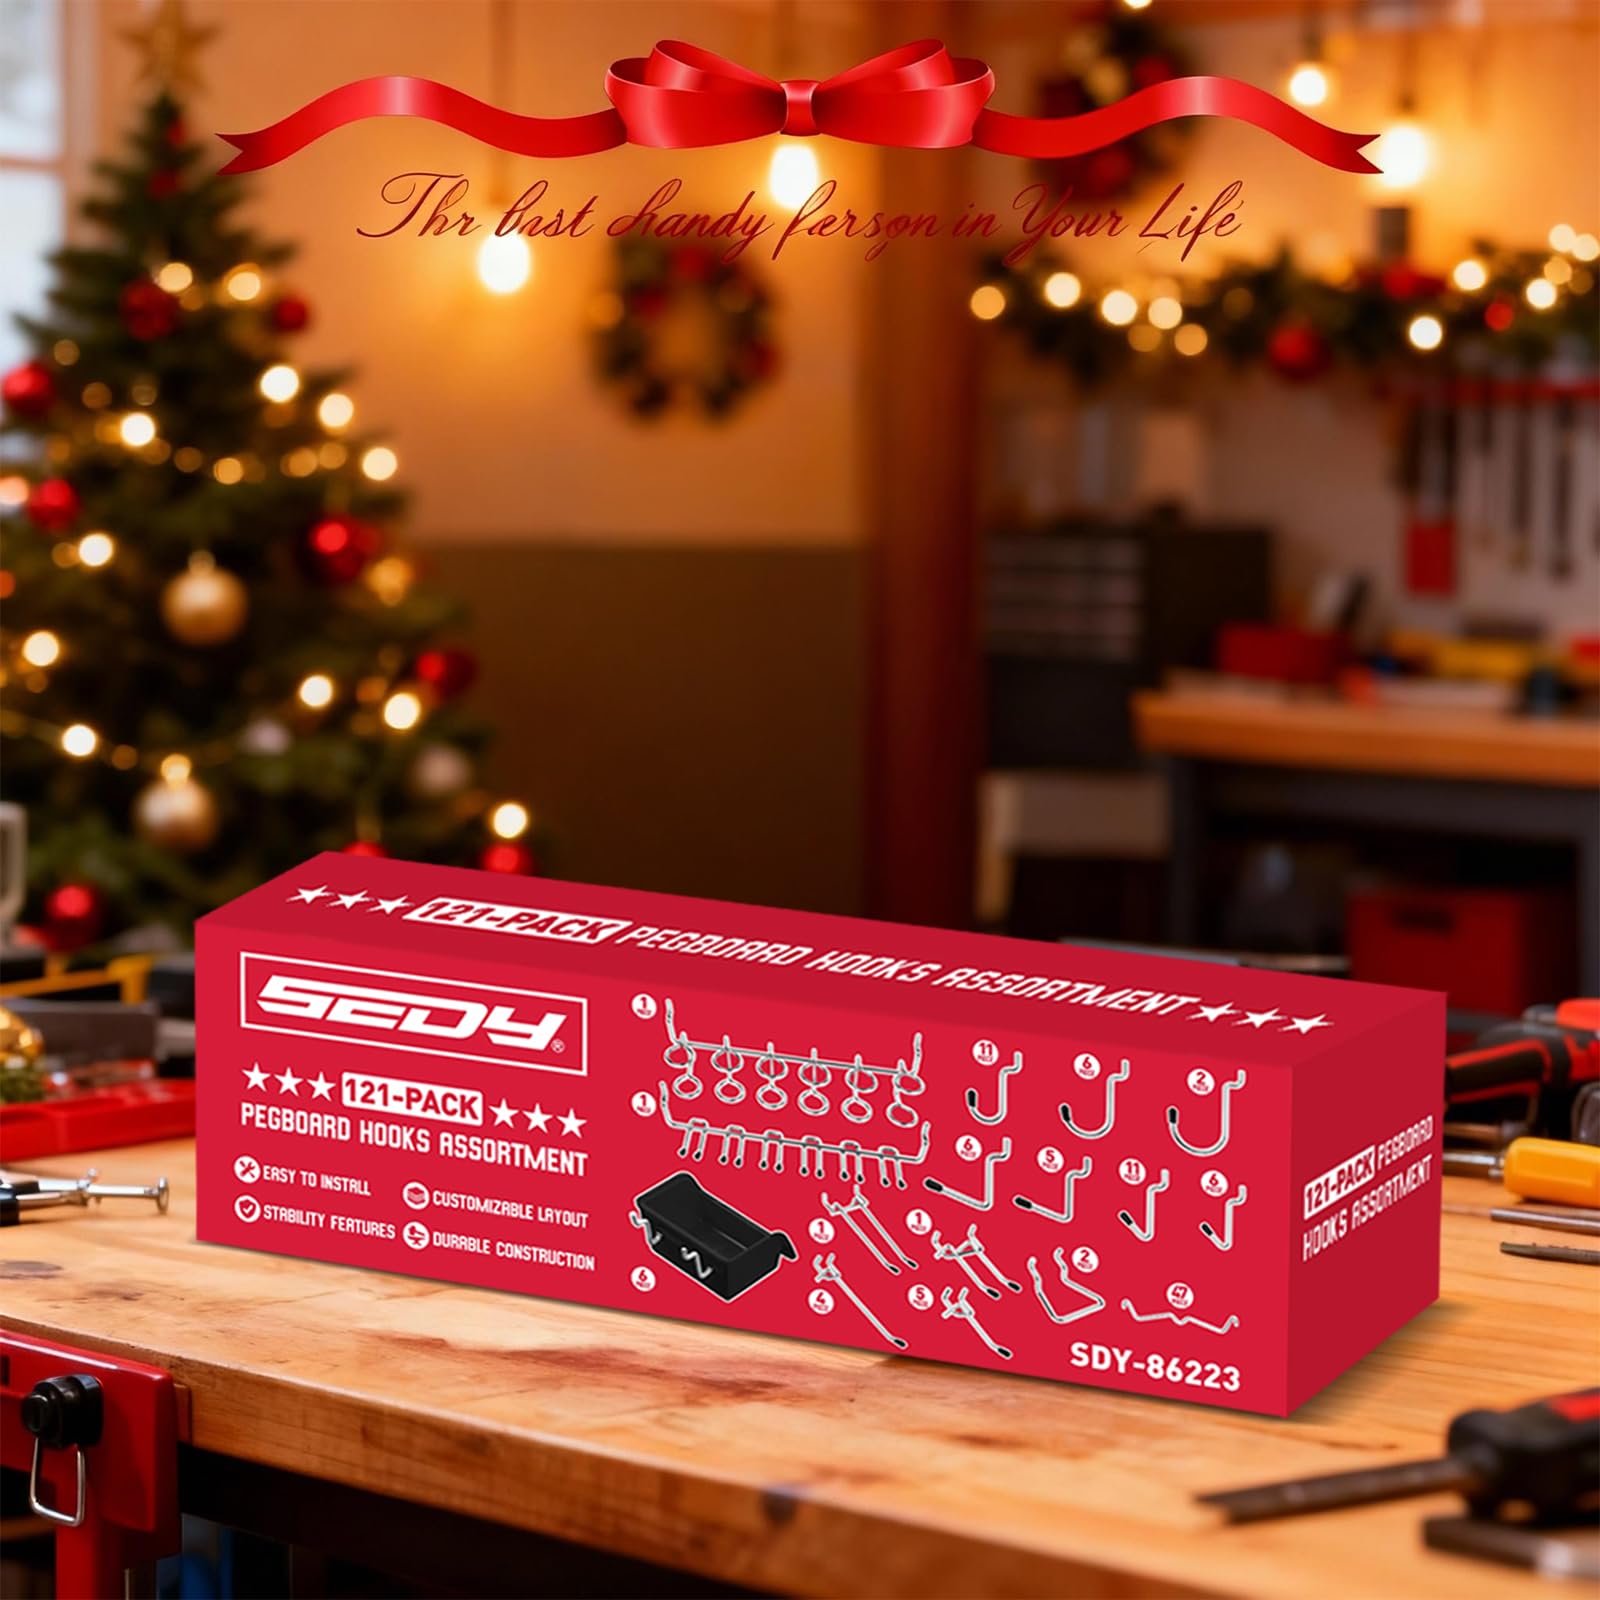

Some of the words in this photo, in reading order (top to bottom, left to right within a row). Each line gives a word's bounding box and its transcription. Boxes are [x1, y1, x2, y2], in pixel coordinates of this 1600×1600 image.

[416, 901, 623, 942] 121-PACK
[615, 926, 813, 965] PEGBOARD
[804, 950, 942, 983] HOOKS
[931, 967, 1202, 1015] ASSORTMENT
[344, 1077, 480, 1120] 121-PACK
[241, 1101, 351, 1142] PEGBOARD
[360, 1119, 430, 1153] HOOKS
[439, 1131, 588, 1177] ASSORTMENT
[263, 1164, 296, 1184] EASY
[300, 1170, 317, 1188] TO
[320, 1173, 371, 1196] INSTALL
[1305, 1149, 1374, 1213] 121-PACK
[263, 1204, 326, 1229] STABILITY
[330, 1214, 396, 1240] FEATURES
[432, 1189, 534, 1221] CUSTOMIZABLE
[538, 1206, 588, 1228] LAYOUT
[1303, 1207, 1348, 1262] HOOKS
[1351, 1154, 1432, 1230] ASSORTMENT
[432, 1230, 491, 1255] DURABLE
[495, 1240, 595, 1272] CONSTRUCTION
[1070, 1341, 1240, 1392] SDY-86223
